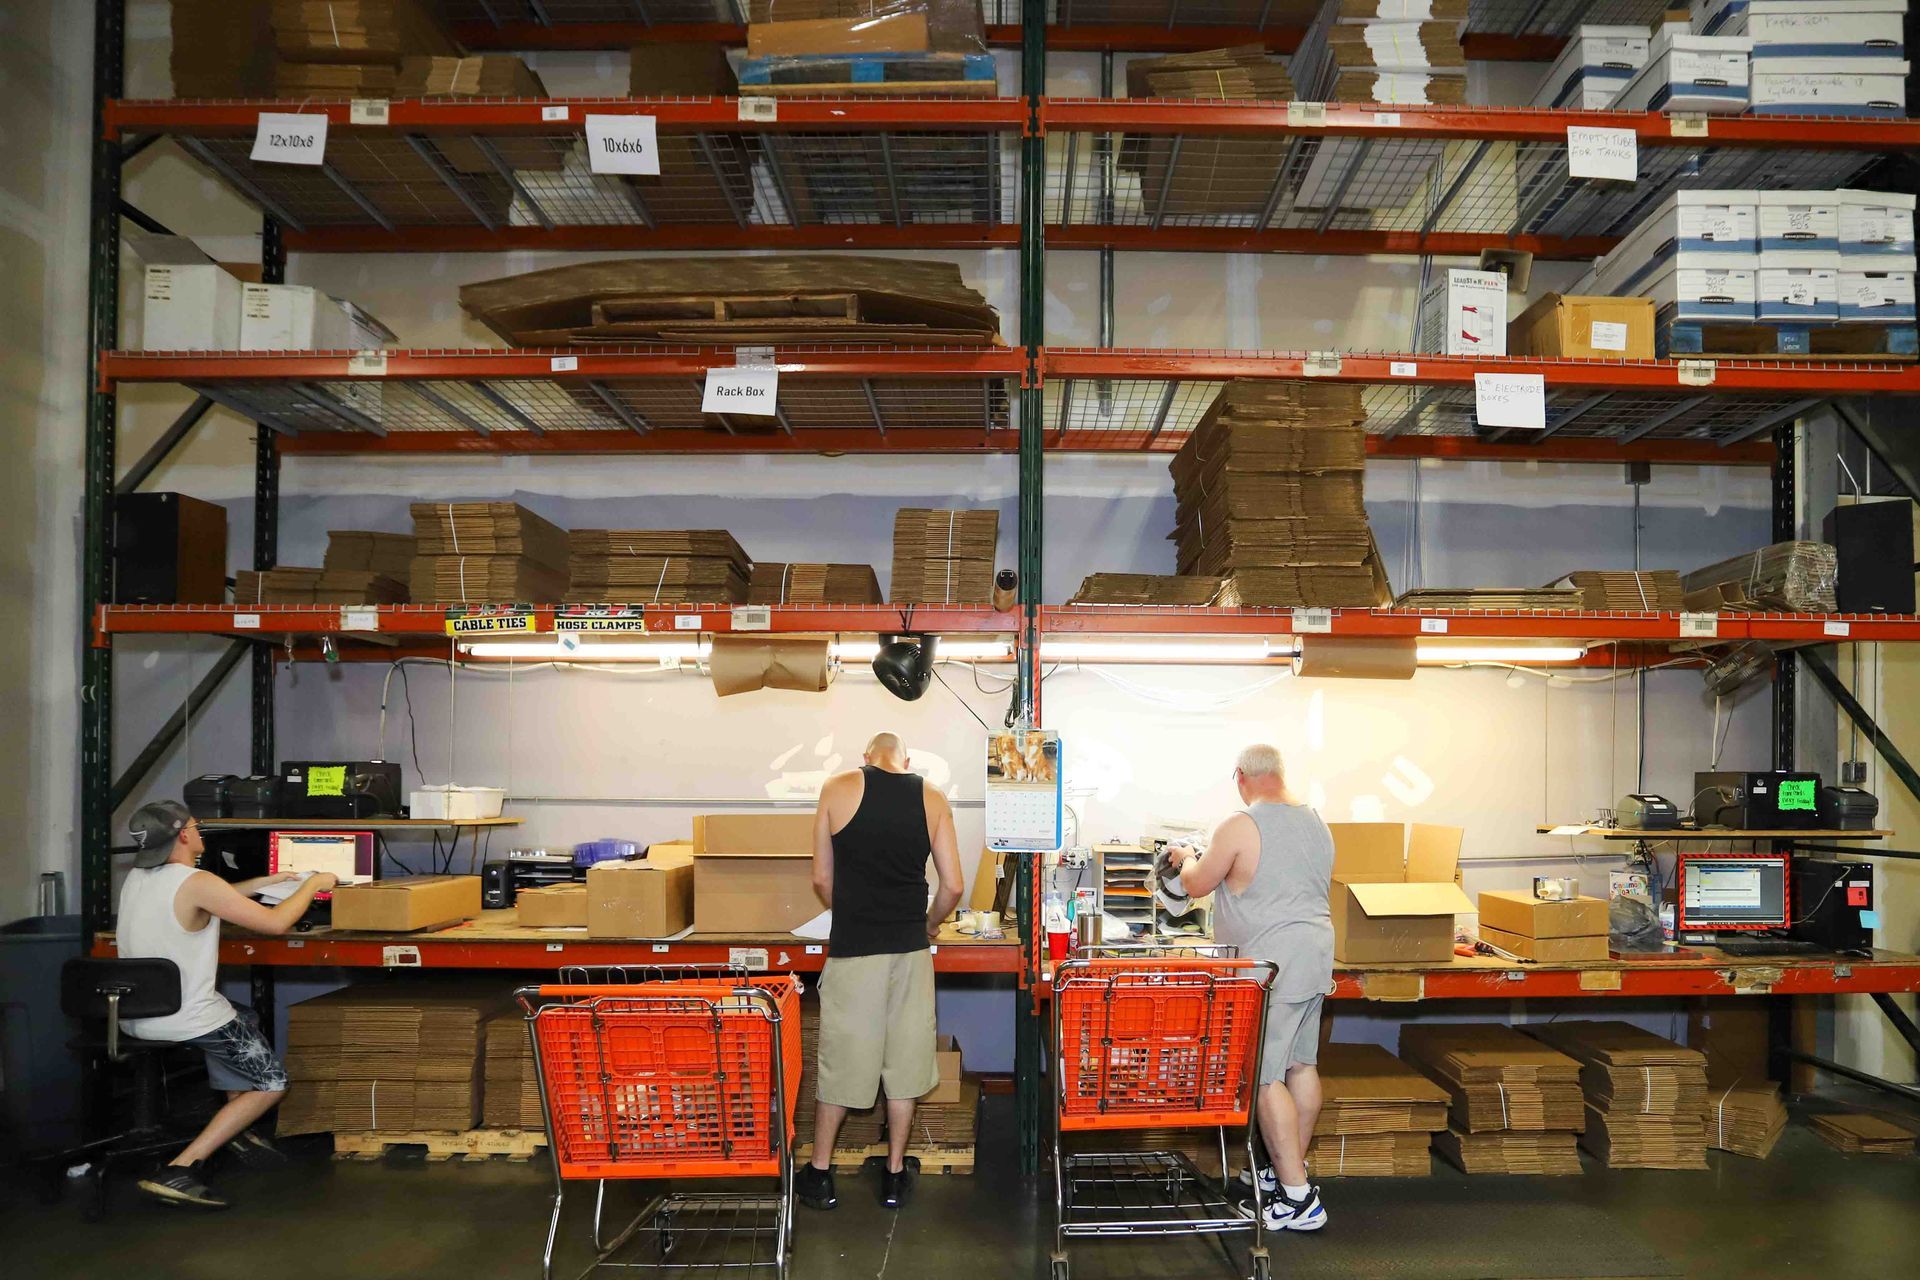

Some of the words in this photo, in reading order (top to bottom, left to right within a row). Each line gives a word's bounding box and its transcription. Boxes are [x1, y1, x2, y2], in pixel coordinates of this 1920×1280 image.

[269, 134, 314, 148] 12x10x8
[1571, 131, 1610, 145] EMPTY
[602, 137, 643, 153] 10x6x6
[1571, 146, 1592, 158] FOR
[1597, 147, 1631, 159] TANKS
[716, 385, 743, 397] Rack
[745, 386, 765, 397] Box
[1480, 394, 1510, 404] BOXES
[453, 619, 495, 631] CABLE
[497, 617, 527, 629] TIES
[556, 621, 588, 630] HOSE
[591, 621, 642, 630] CLAMPS
